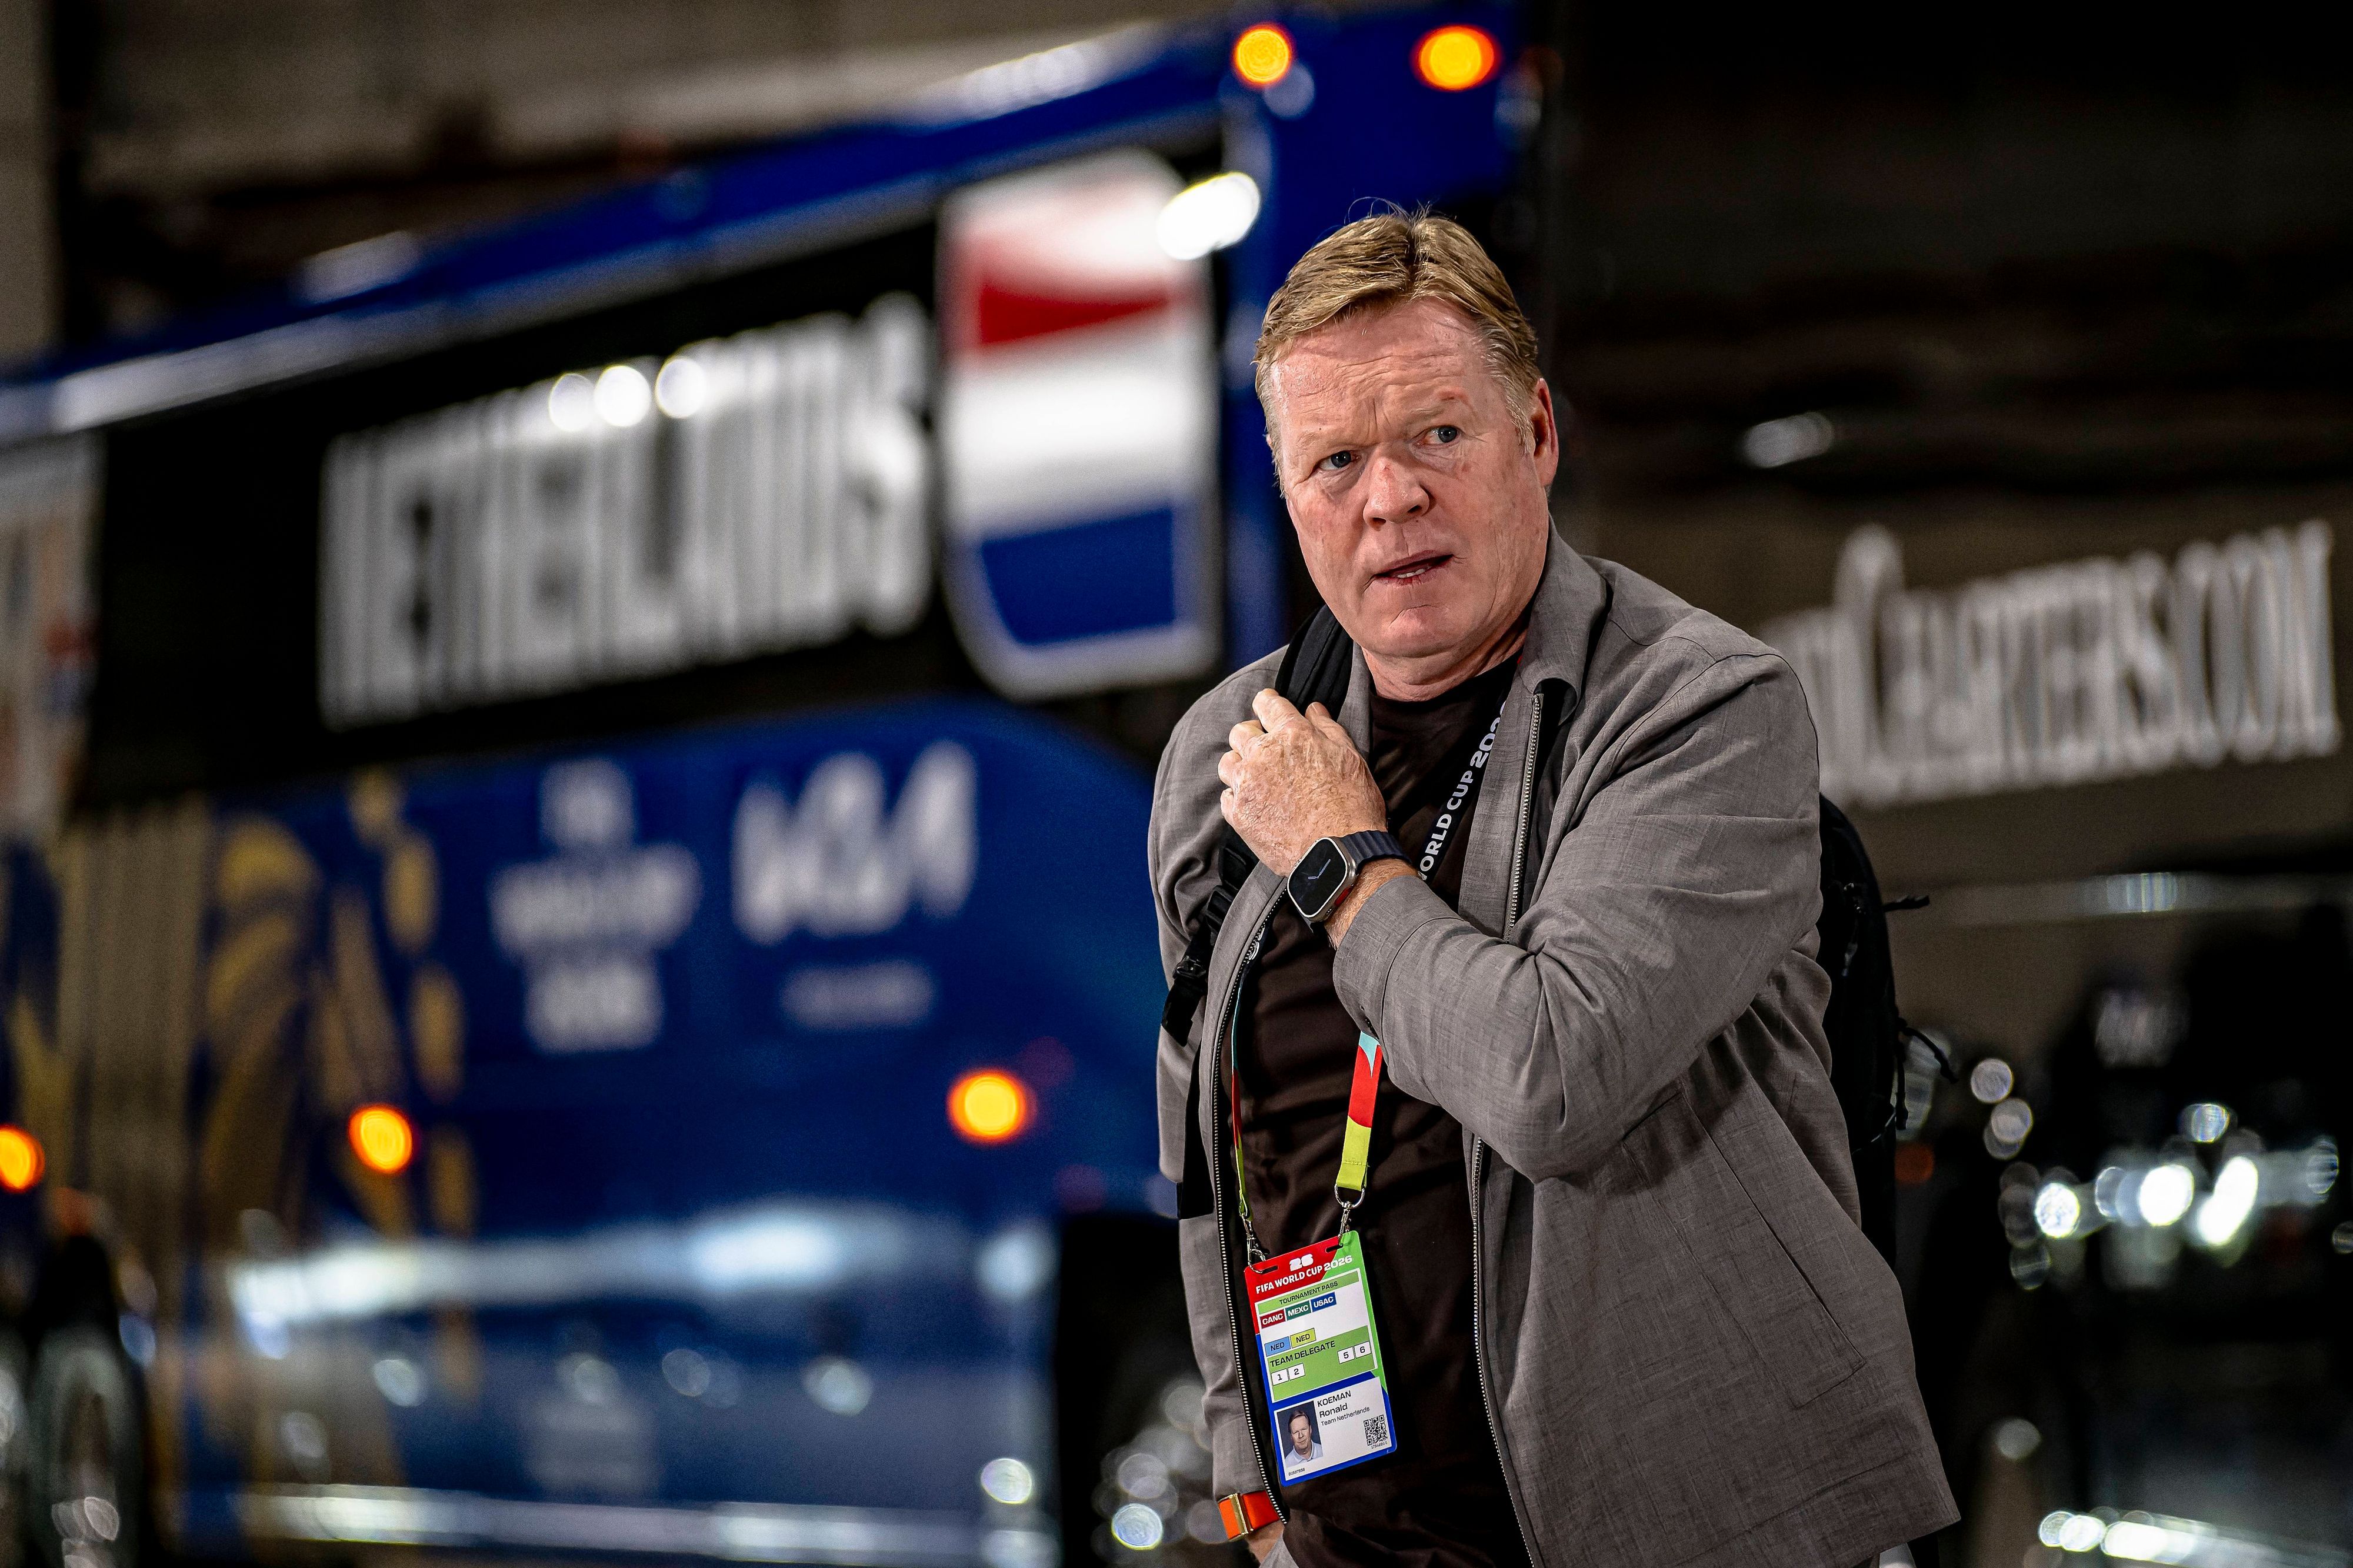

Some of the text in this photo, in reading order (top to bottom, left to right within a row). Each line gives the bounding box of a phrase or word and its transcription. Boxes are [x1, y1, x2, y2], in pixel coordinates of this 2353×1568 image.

[1447, 770, 1473, 810] CUP
[1255, 1255, 1353, 1294] FIFA WORLD CUP 2026
[1279, 1281, 1338, 1305] TOURNAMENT PASS
[1262, 1296, 1334, 1325] CANC MEXC USAC
[1270, 1340, 1336, 1367] TEAM DELEGATE
[1271, 1333, 1310, 1352] NED NED
[1317, 1390, 1351, 1407] KOEMAN
[1319, 1403, 1348, 1418] Ronald
[1321, 1407, 1370, 1426] Team Netherlands
